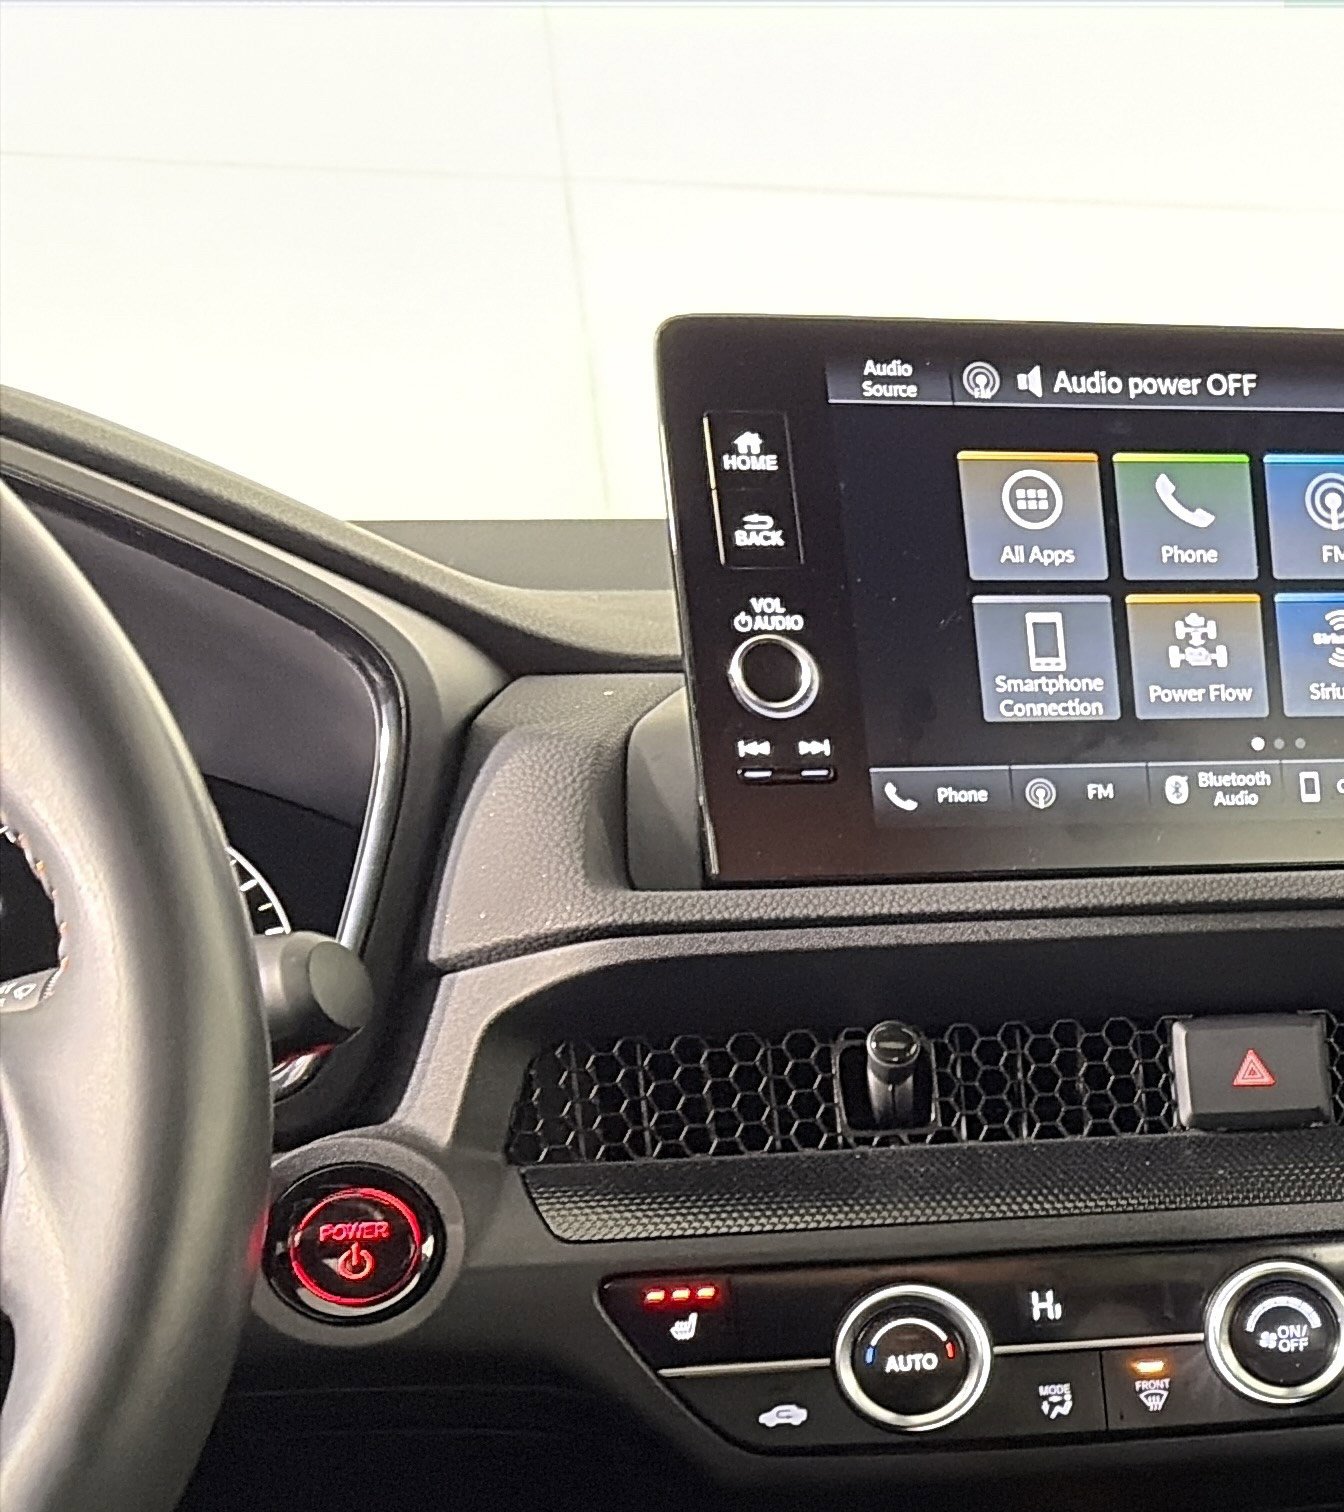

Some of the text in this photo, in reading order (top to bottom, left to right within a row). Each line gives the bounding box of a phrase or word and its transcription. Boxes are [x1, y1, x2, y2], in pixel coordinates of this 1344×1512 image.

[863, 359, 913, 378] Audio
[862, 381, 917, 398] Source
[1053, 371, 1258, 400] Audio power OFF
[723, 455, 778, 471] HOME
[734, 529, 784, 547] BACK
[1001, 546, 1075, 567] All Apps
[1161, 545, 1218, 564] Phone
[750, 598, 786, 614] VOL
[753, 614, 804, 631] AUDIO
[995, 675, 1104, 695] Smartphone
[1149, 684, 1253, 703] Power Flow
[1000, 699, 1104, 717] Connection
[1198, 771, 1271, 789] Bluetooth
[937, 786, 988, 804] Phone
[1087, 784, 1114, 799] FM
[1214, 789, 1259, 807] Audio
[319, 1221, 389, 1242] POWER
[1277, 1325, 1308, 1338] ON/
[1278, 1338, 1308, 1353] OFF
[885, 1353, 938, 1374] AUTO
[1038, 1383, 1071, 1396] MODE
[1134, 1378, 1171, 1392] FRONT
